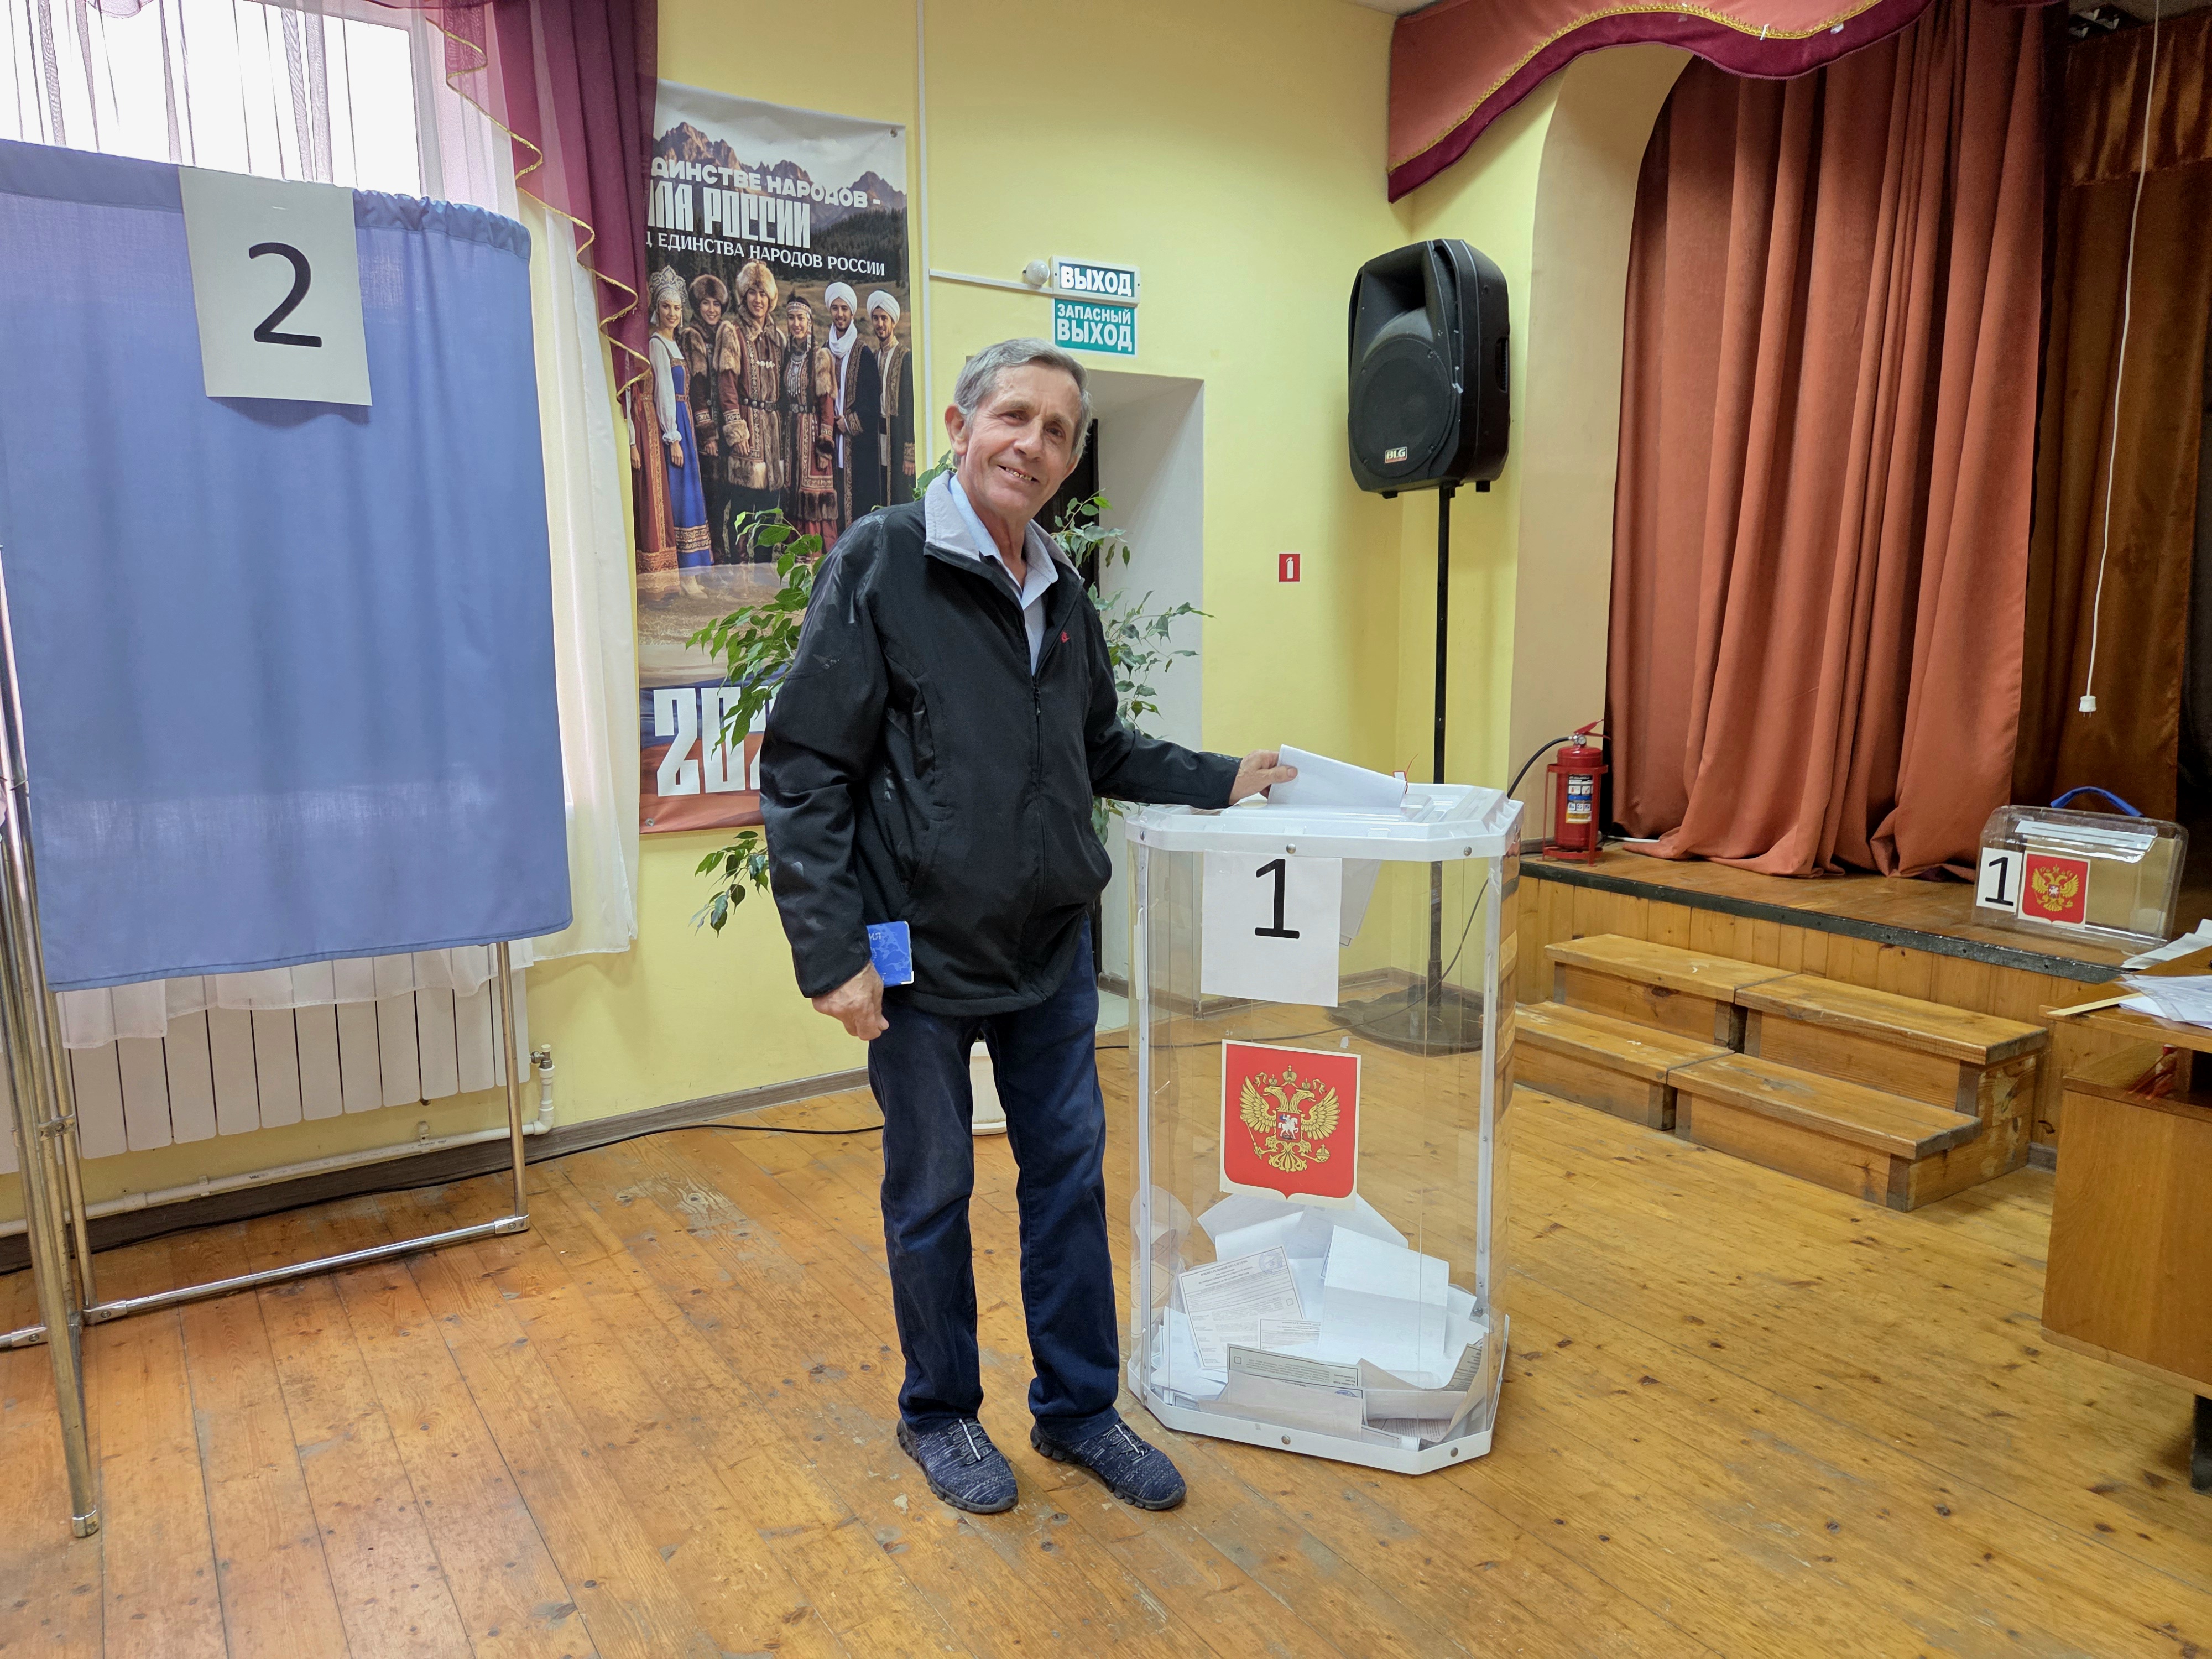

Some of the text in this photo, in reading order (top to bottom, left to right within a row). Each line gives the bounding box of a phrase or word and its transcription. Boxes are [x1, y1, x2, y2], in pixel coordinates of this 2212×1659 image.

[766, 175, 868, 208] НАРОДОВ
[703, 186, 811, 248] РОССИИ
[658, 232, 745, 258] ЕДИНСТВА
[749, 244, 823, 268] НАРОДОВ
[827, 255, 885, 276] РОССИИ
[248, 242, 322, 348] 2
[1060, 265, 1132, 296] ВЫХОД
[1057, 304, 1131, 324] ЗАПАСНЫЙ
[1057, 318, 1133, 352] ВЫХОД
[1254, 858, 1300, 939] 1
[1985, 857, 2014, 906] 1
